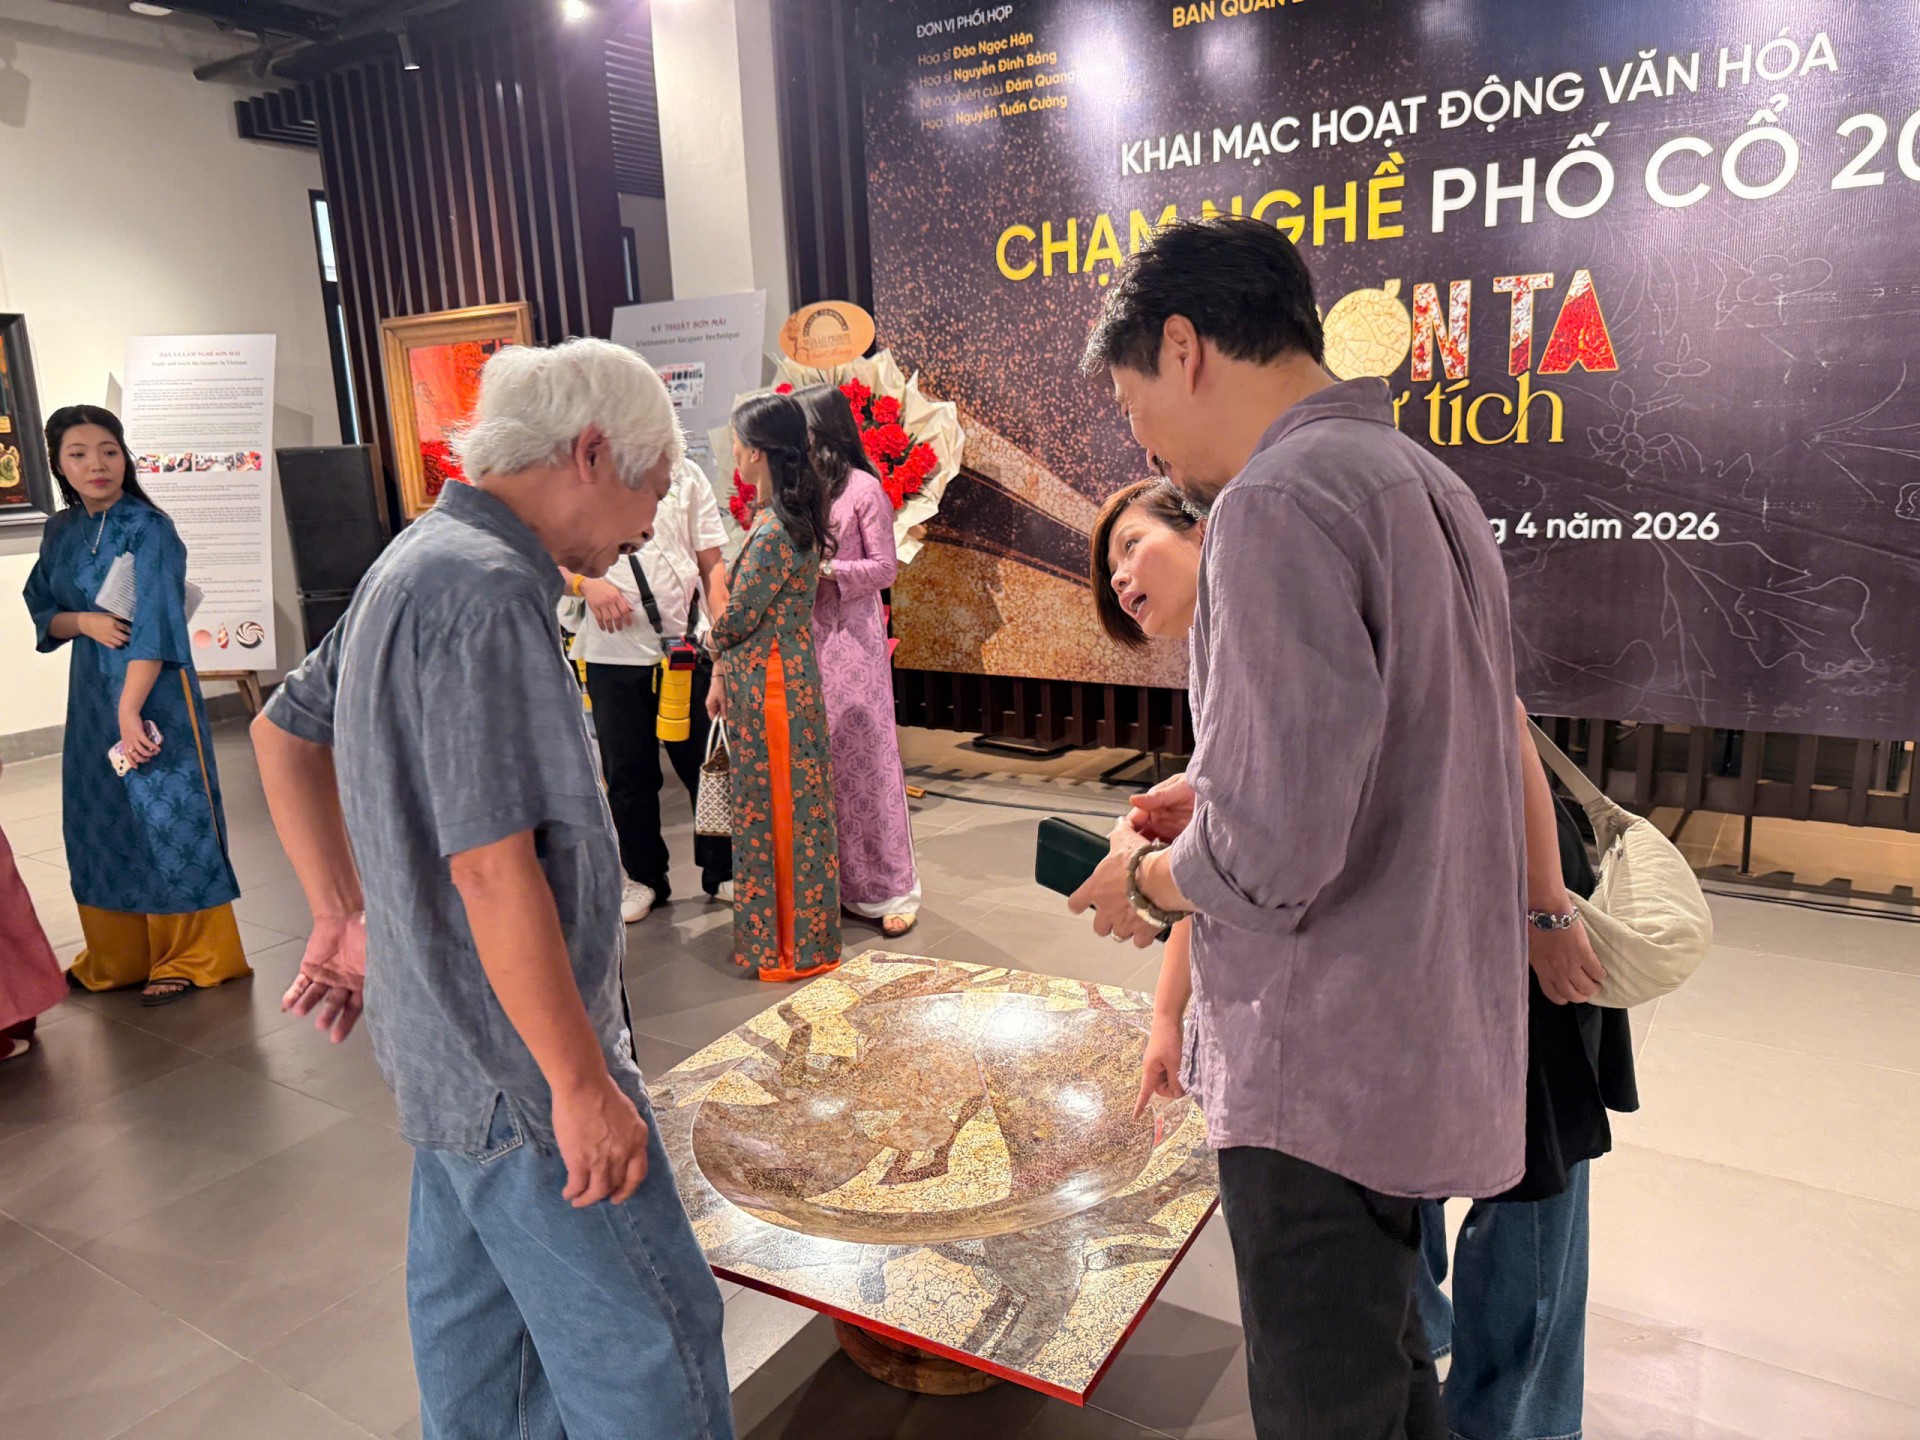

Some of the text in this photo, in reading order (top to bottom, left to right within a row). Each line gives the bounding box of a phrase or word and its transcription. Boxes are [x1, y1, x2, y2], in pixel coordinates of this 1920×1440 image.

[916, 5, 1013, 38] ĐƠN VỊ PHỐI HỢP
[1172, 0, 1215, 28] BAN
[953, 45, 976, 59] Đào
[978, 38, 1008, 56] Ngọc
[1010, 32, 1034, 48] Hân
[954, 60, 996, 84] Nguyễn
[956, 103, 997, 126] Nguyễn
[999, 98, 1027, 117] Tuấn
[1029, 94, 1068, 113] Cường
[1121, 27, 1840, 177] KHAI MẠC HOẠT ĐỘNG VĂN HÓA
[1431, 121, 1615, 233] PHỐ
[1645, 94, 1800, 208] CỔ
[1318, 269, 1619, 382] ƠN TA
[1423, 371, 1565, 447] tích
[1515, 511, 1538, 539] 4
[1546, 511, 1622, 540] năm
[1631, 510, 1720, 541] 2026
